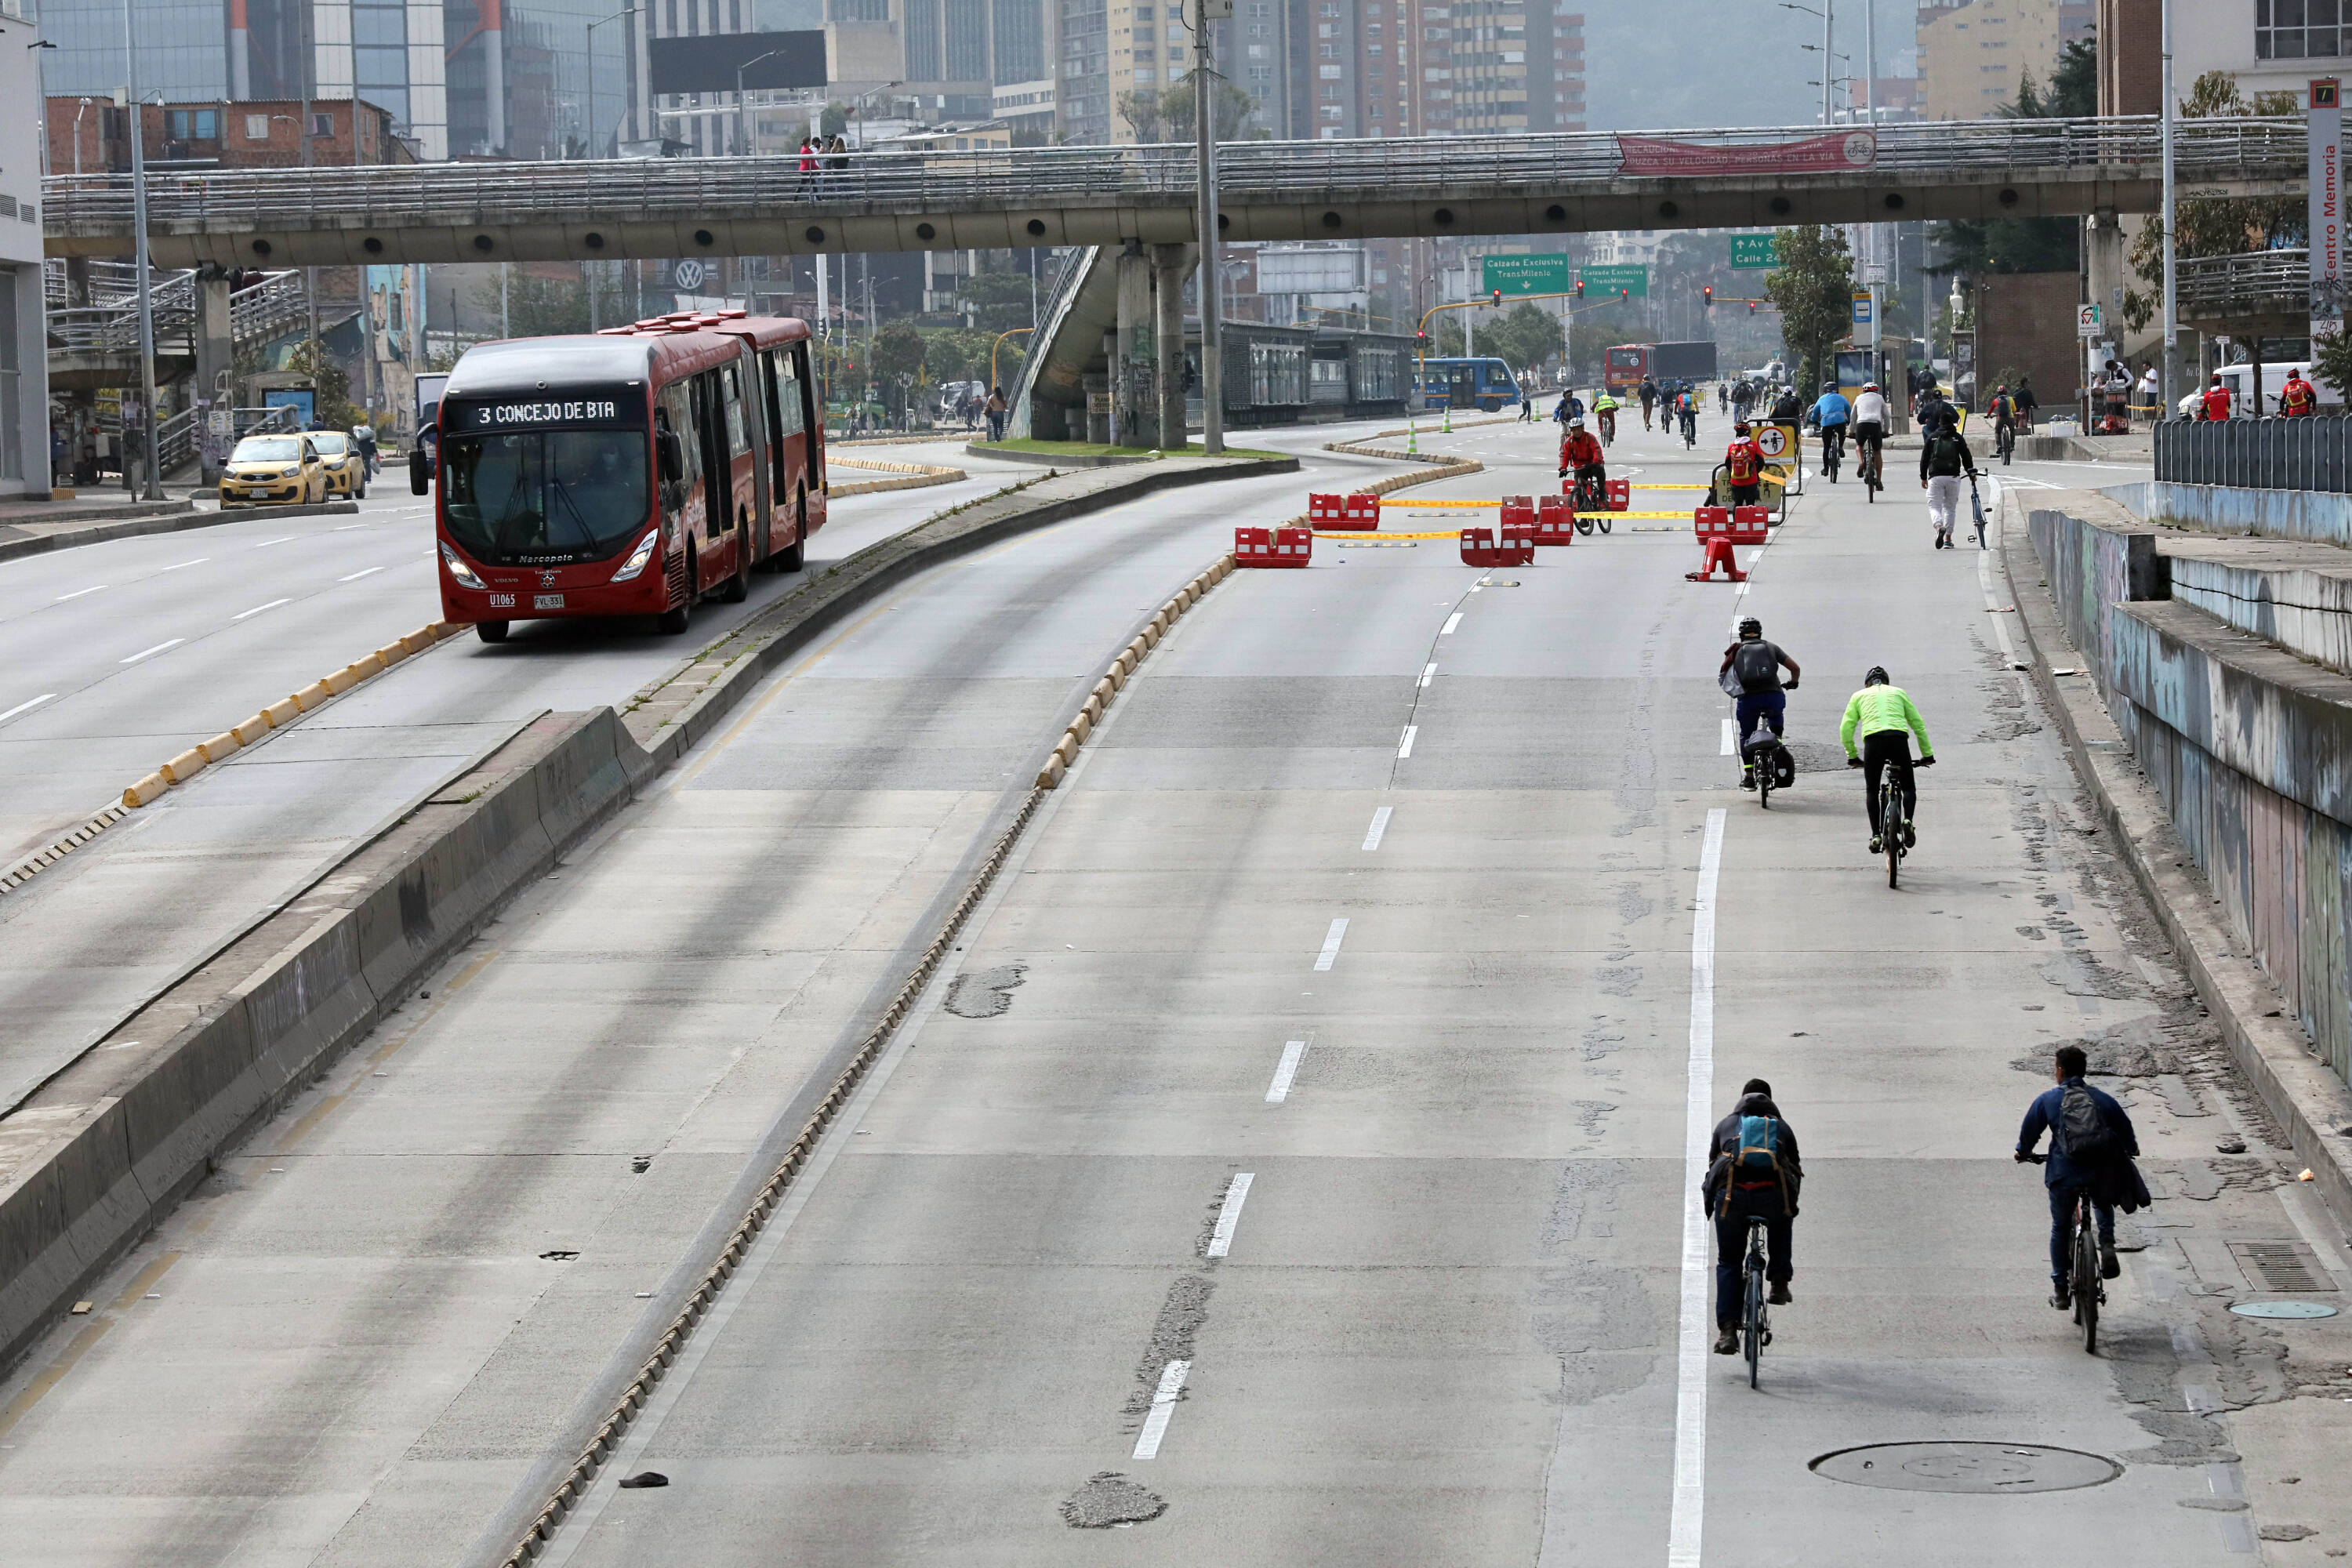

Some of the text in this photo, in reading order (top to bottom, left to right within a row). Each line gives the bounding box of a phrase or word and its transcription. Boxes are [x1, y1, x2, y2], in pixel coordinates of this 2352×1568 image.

[1788, 154, 1799, 162] EN
[1803, 153, 1815, 162] LA
[2323, 144, 2337, 280] Centro Memoria
[1749, 239, 1763, 248] Av
[1736, 254, 1762, 263] Calle
[478, 401, 615, 423] 3 CONCEJO DE BTA
[519, 554, 573, 563] Marcopolo
[490, 594, 515, 605] U1065
